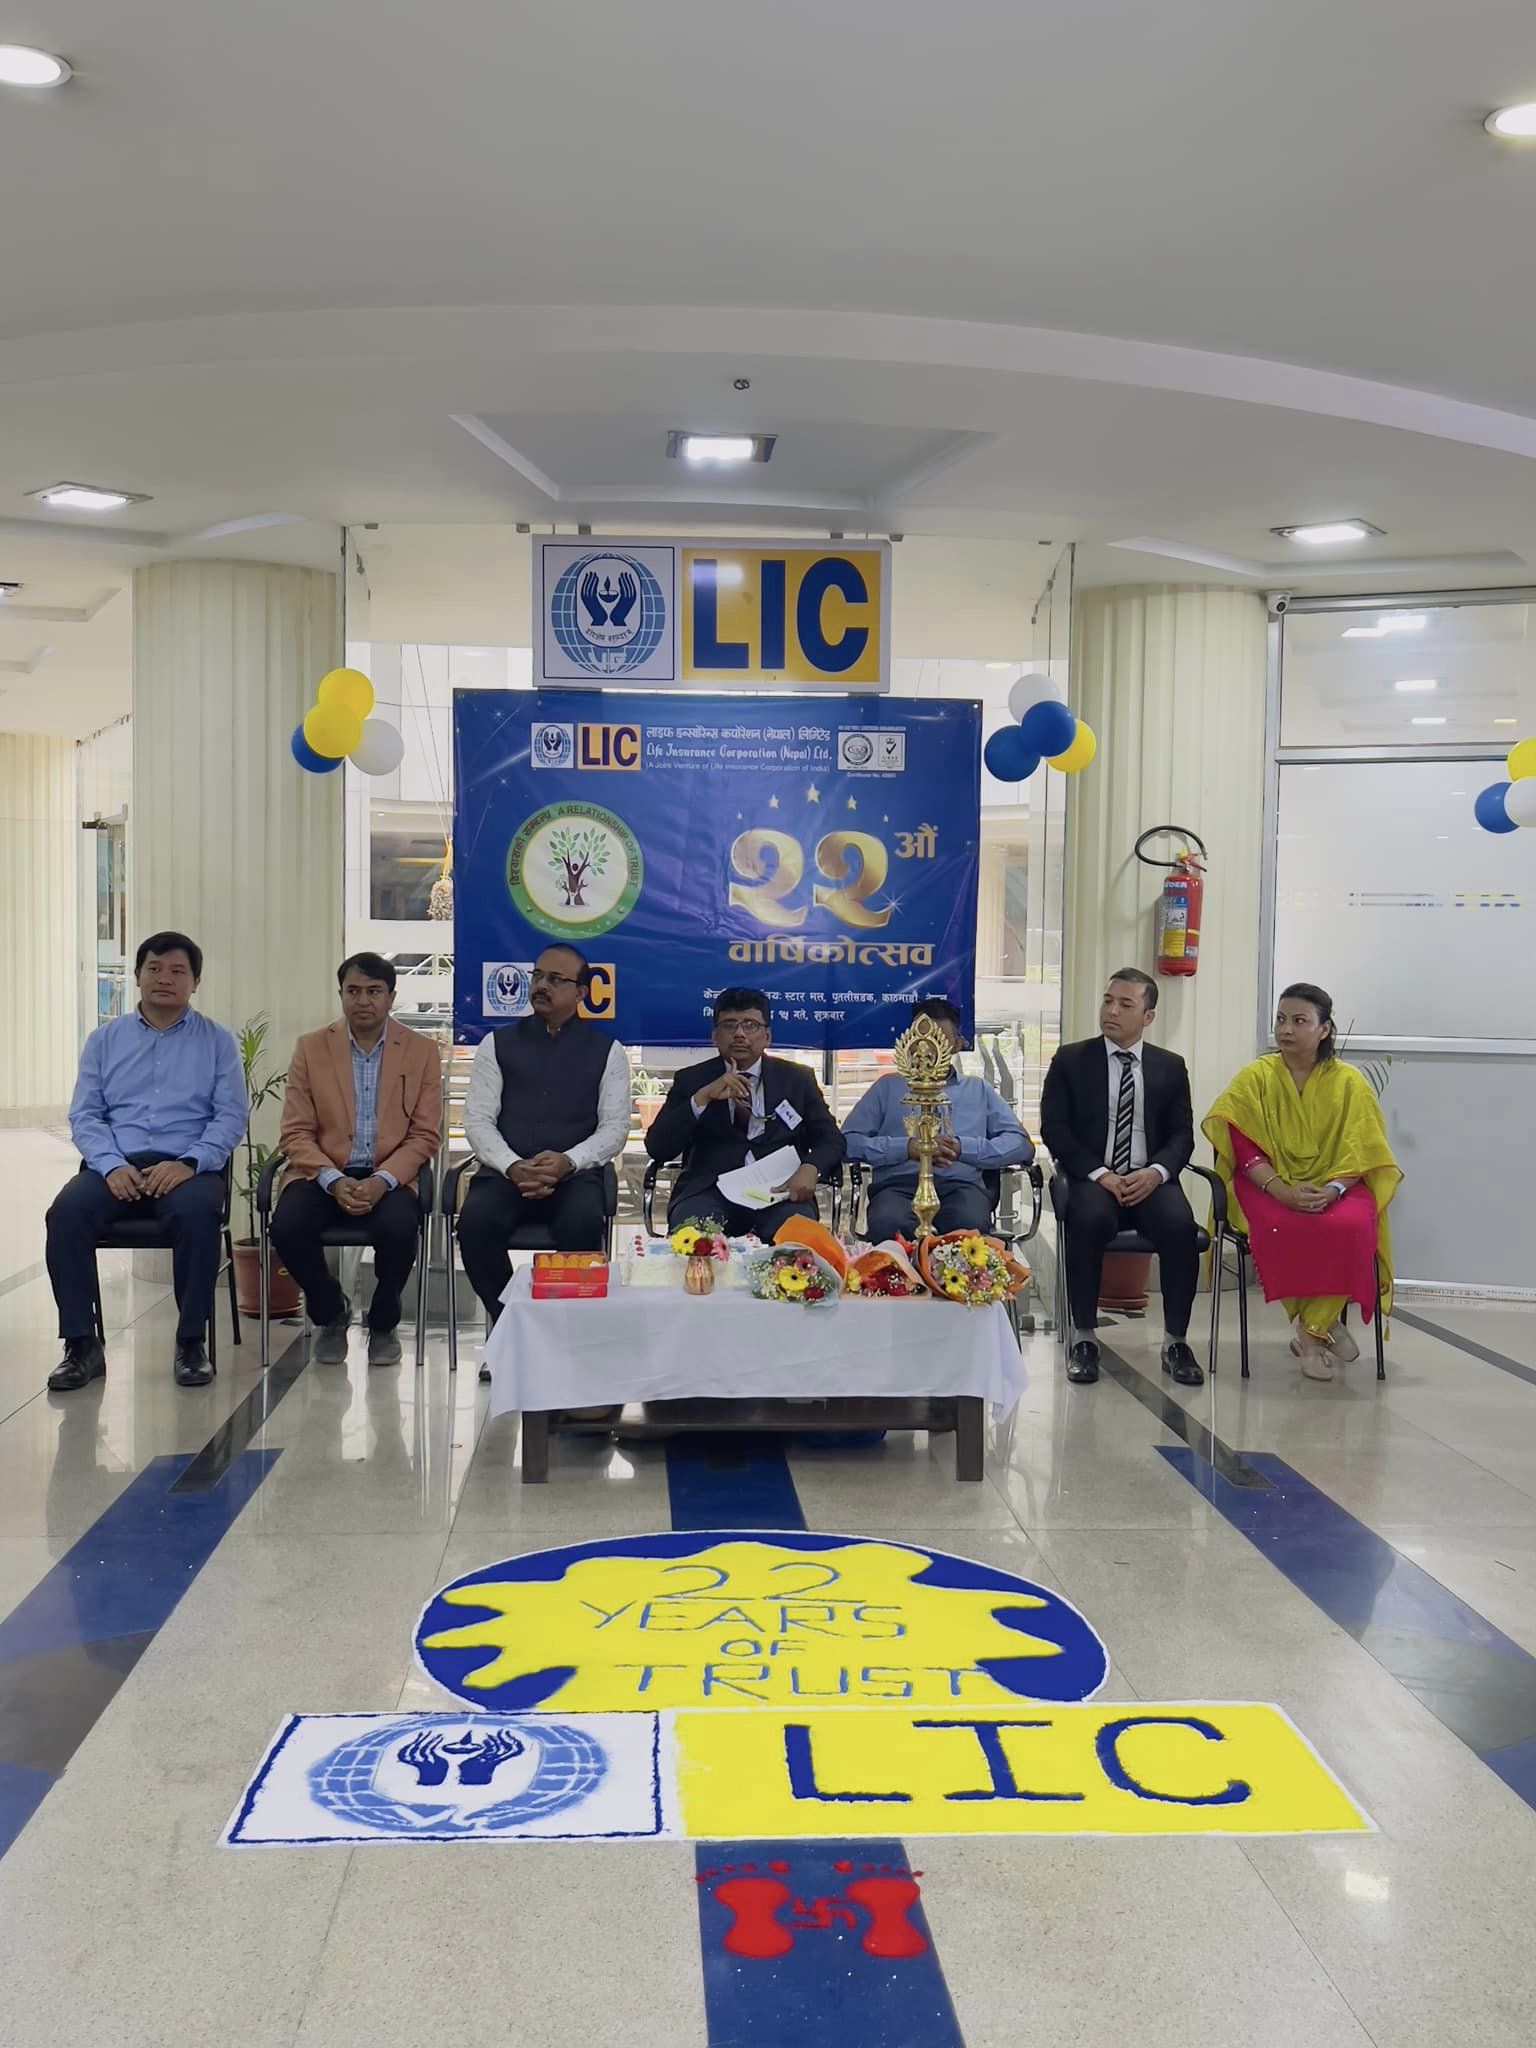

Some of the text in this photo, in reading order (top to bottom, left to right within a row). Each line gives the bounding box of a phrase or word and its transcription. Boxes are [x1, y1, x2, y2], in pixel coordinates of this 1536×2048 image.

[693, 557, 869, 673] LIC
[582, 727, 637, 766] LIC
[646, 742, 663, 759] Life
[666, 743, 716, 758] Insurance
[720, 744, 777, 760] Corporation
[780, 745, 811, 761] (Nepal)
[814, 745, 833, 760] Ltd.
[799, 726, 831, 741] लिमिटेड
[558, 806, 565, 816] A
[566, 804, 629, 839] RELATIONSHIP
[729, 829, 893, 928] २२
[728, 934, 936, 967] वार्षिकोत्सव
[654, 1562, 866, 1604] 22
[580, 1600, 907, 1639] YEARS
[720, 1638, 806, 1658] OF
[613, 1663, 988, 1701] TRUST
[783, 1715, 1252, 1807] LIC
